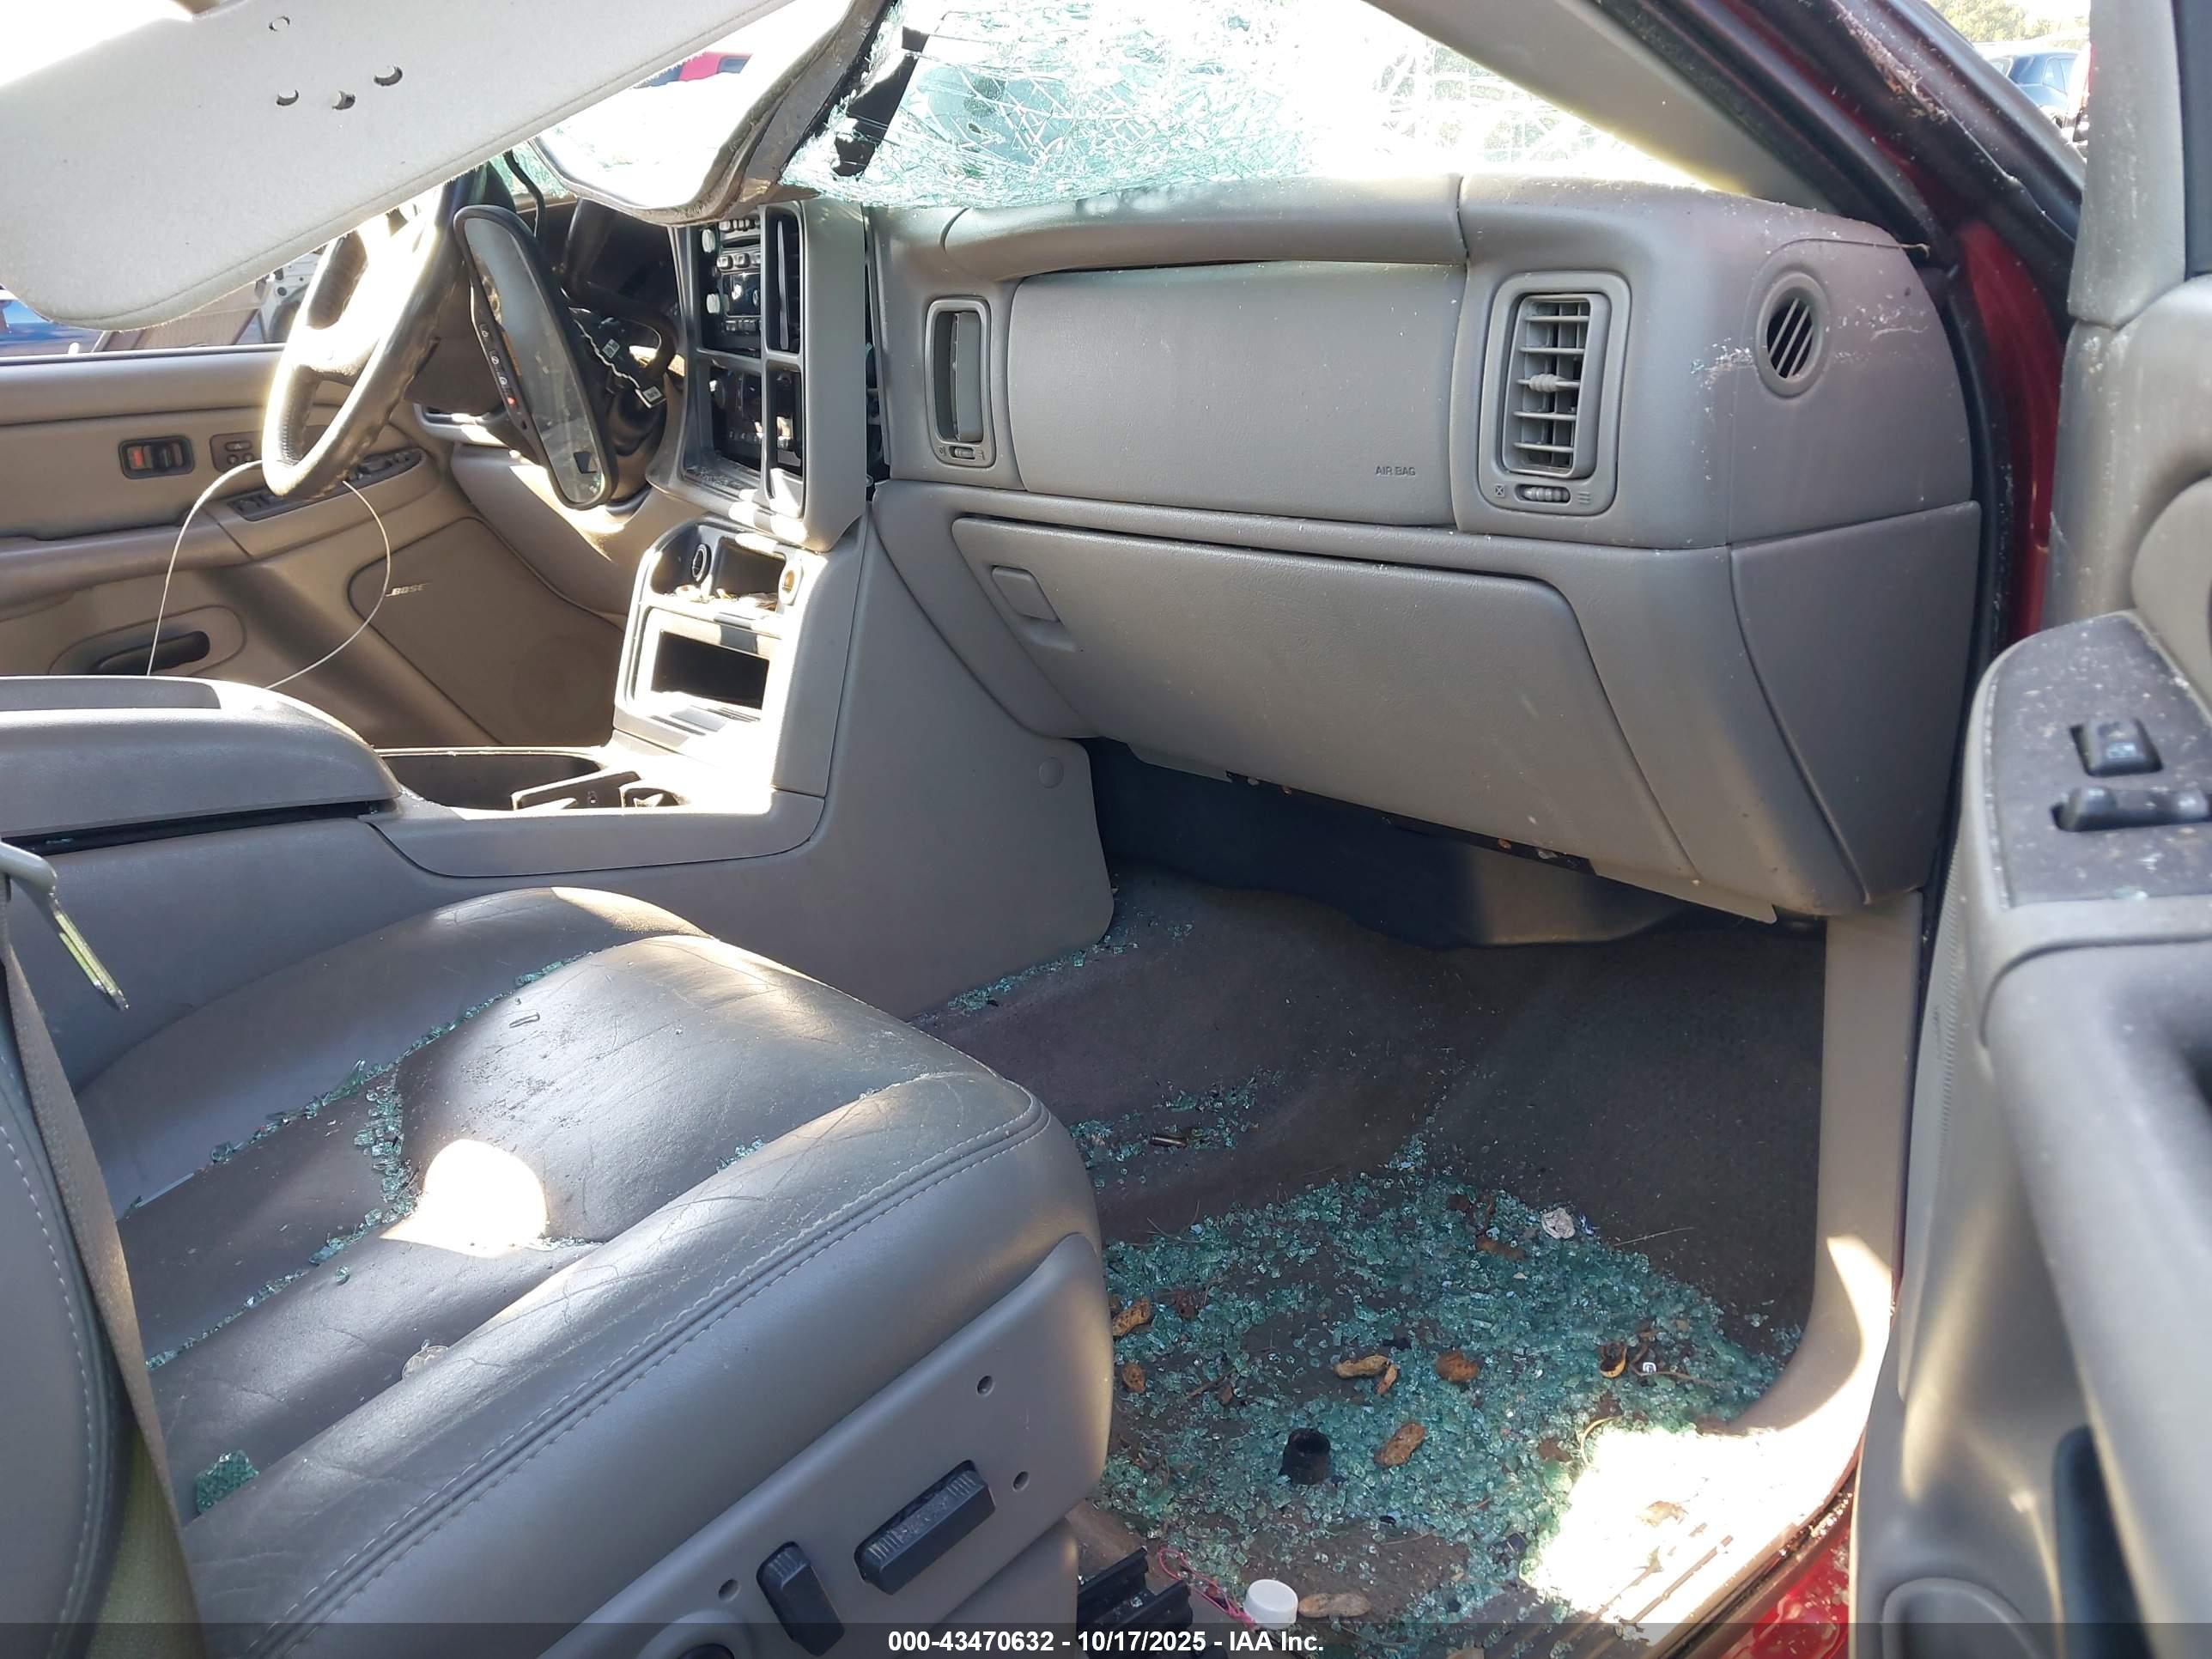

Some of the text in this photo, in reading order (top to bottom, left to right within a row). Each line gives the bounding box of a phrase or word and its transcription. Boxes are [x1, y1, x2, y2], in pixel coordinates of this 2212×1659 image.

[1376, 465, 1416, 476] AIR BAG
[386, 583, 429, 597] BOSE
